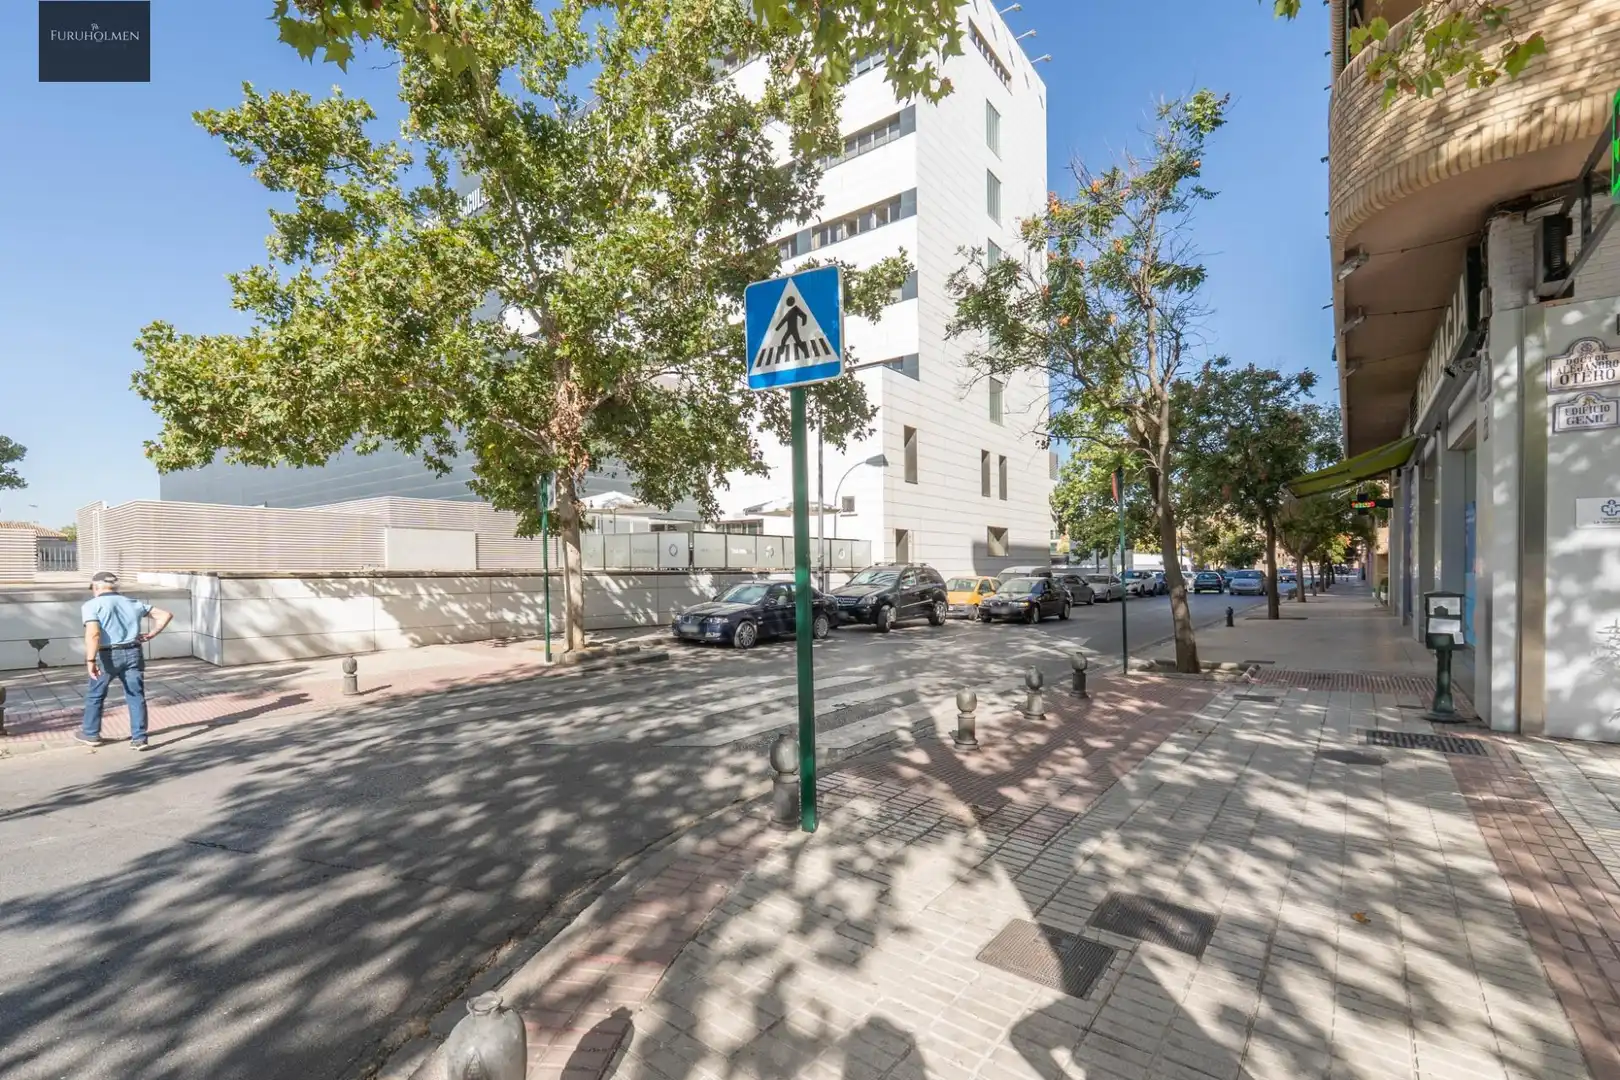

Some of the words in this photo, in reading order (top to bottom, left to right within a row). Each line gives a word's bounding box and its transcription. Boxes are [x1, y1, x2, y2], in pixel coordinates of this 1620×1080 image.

[1417, 274, 1468, 418] FARMACIA
[1557, 359, 1619, 375] ALEJANDRO
[1566, 354, 1609, 366] DOCTOR
[1560, 368, 1616, 385] OTERO
[1565, 404, 1610, 416] EDIFICIO
[1566, 414, 1604, 426] GENIL
